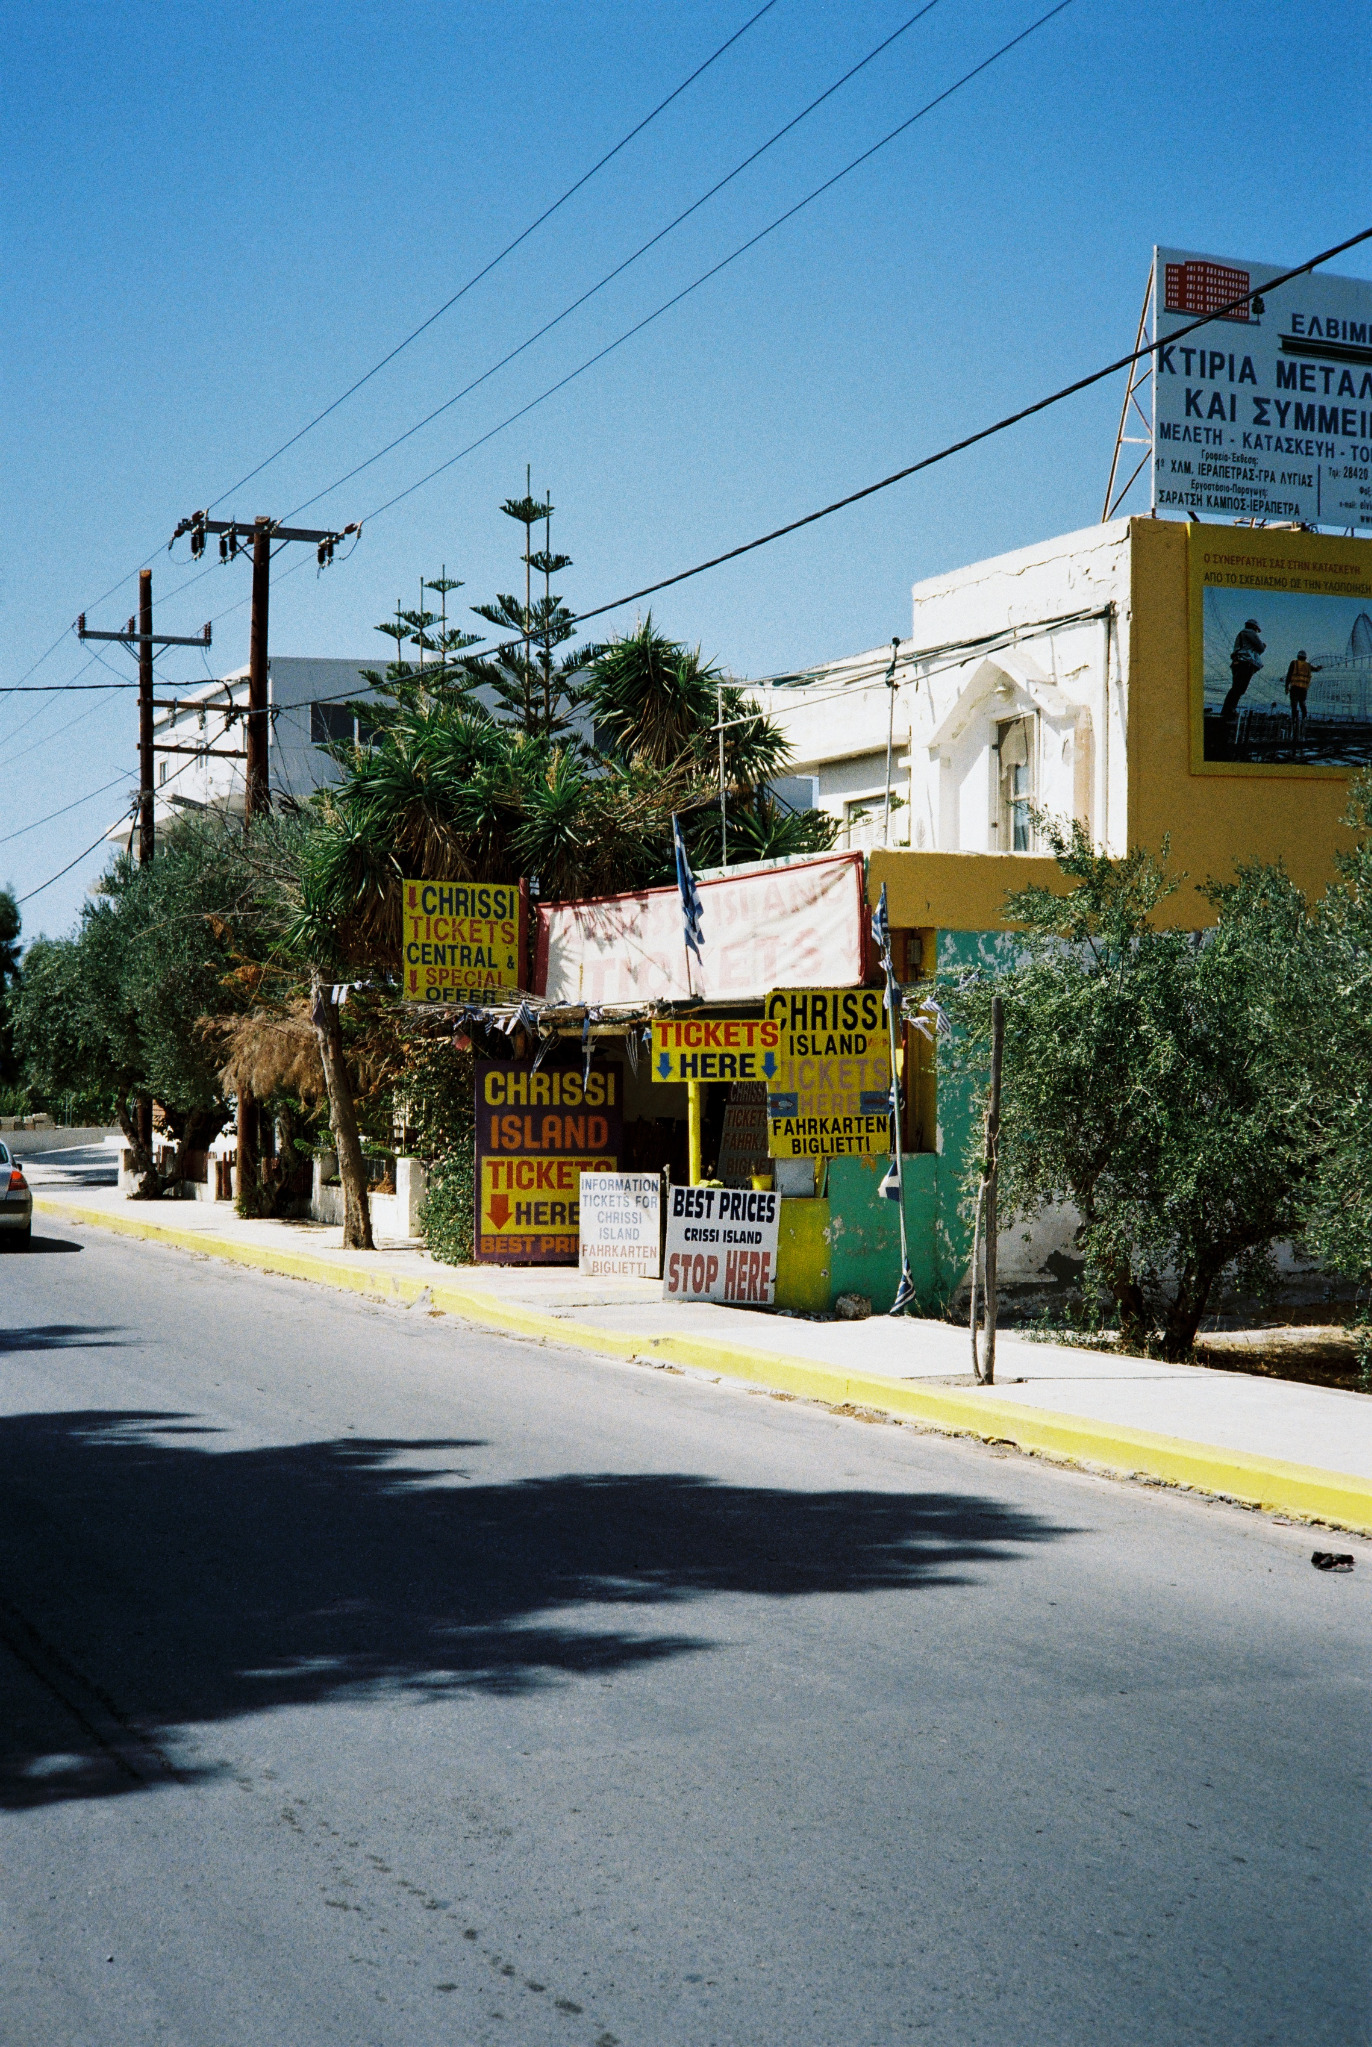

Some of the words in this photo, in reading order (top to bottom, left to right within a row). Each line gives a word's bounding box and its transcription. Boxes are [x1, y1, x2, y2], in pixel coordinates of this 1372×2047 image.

[1292, 313, 1372, 344] ΕΛΒΙΜ
[1158, 345, 1257, 385] ΚΤΙΡΙΑ
[1185, 387, 1236, 422] ΚΑΙ
[1252, 396, 1372, 439] ΣΥΜΜΕΙ
[1159, 422, 1222, 445] ΜΕΛΕΤΗ
[1243, 432, 1335, 458] ΚΑΤΑΣΚΕΥΗ
[1350, 444, 1372, 463] ΤΟ
[1171, 459, 1194, 475] ΧΛΜ.
[1198, 462, 1275, 483] ΙΕΡΑΠΕΤΡΑΣ-ΓΡΑ
[1280, 472, 1313, 487] ΛΥΓΙΑΣ
[1158, 489, 1203, 507] ΣΑΡΑΤΣΗ
[1207, 494, 1300, 516] ΚΑΜΠΟΣ-ΙΕΡΑΠΕΤΡΑ
[1204, 572, 1223, 583] ΑΠΟ
[1225, 573, 1237, 584] ΤΟ
[1239, 574, 1288, 588] ΣΧΕΔΙΑΣΜΟ
[421, 886, 514, 920] CHRISSI
[409, 915, 515, 945] TICKETS
[407, 942, 498, 968] CENTRAL
[506, 955, 515, 969] &
[425, 967, 503, 988] SPECIAL
[769, 994, 887, 1031] CHRISSI
[655, 1021, 779, 1048] TICKETS
[789, 1034, 867, 1056] ISLAND
[680, 1053, 756, 1078] HERE
[484, 1071, 615, 1106] CHRISSI
[800, 1093, 859, 1116] HERE
[490, 1115, 609, 1149] ISLAND
[772, 1117, 887, 1136] FAHRKARTEN
[791, 1136, 870, 1155] BIGLIETTI
[581, 1178, 659, 1192] INFORMATION
[583, 1195, 630, 1208] TICKETS
[635, 1195, 658, 1208] FOR
[673, 1188, 715, 1219] BEST
[719, 1191, 776, 1223] PRICES
[597, 1211, 642, 1224] CHRISSI
[480, 1236, 536, 1254] BEST
[599, 1228, 640, 1240] ISLAND
[684, 1228, 720, 1243] CRISSI
[722, 1230, 763, 1245] ISLAND
[582, 1244, 657, 1258] FAHRKARTEN
[592, 1261, 646, 1275] BIGLIETTI
[668, 1252, 719, 1294] STOP
[724, 1249, 771, 1302] HERE
